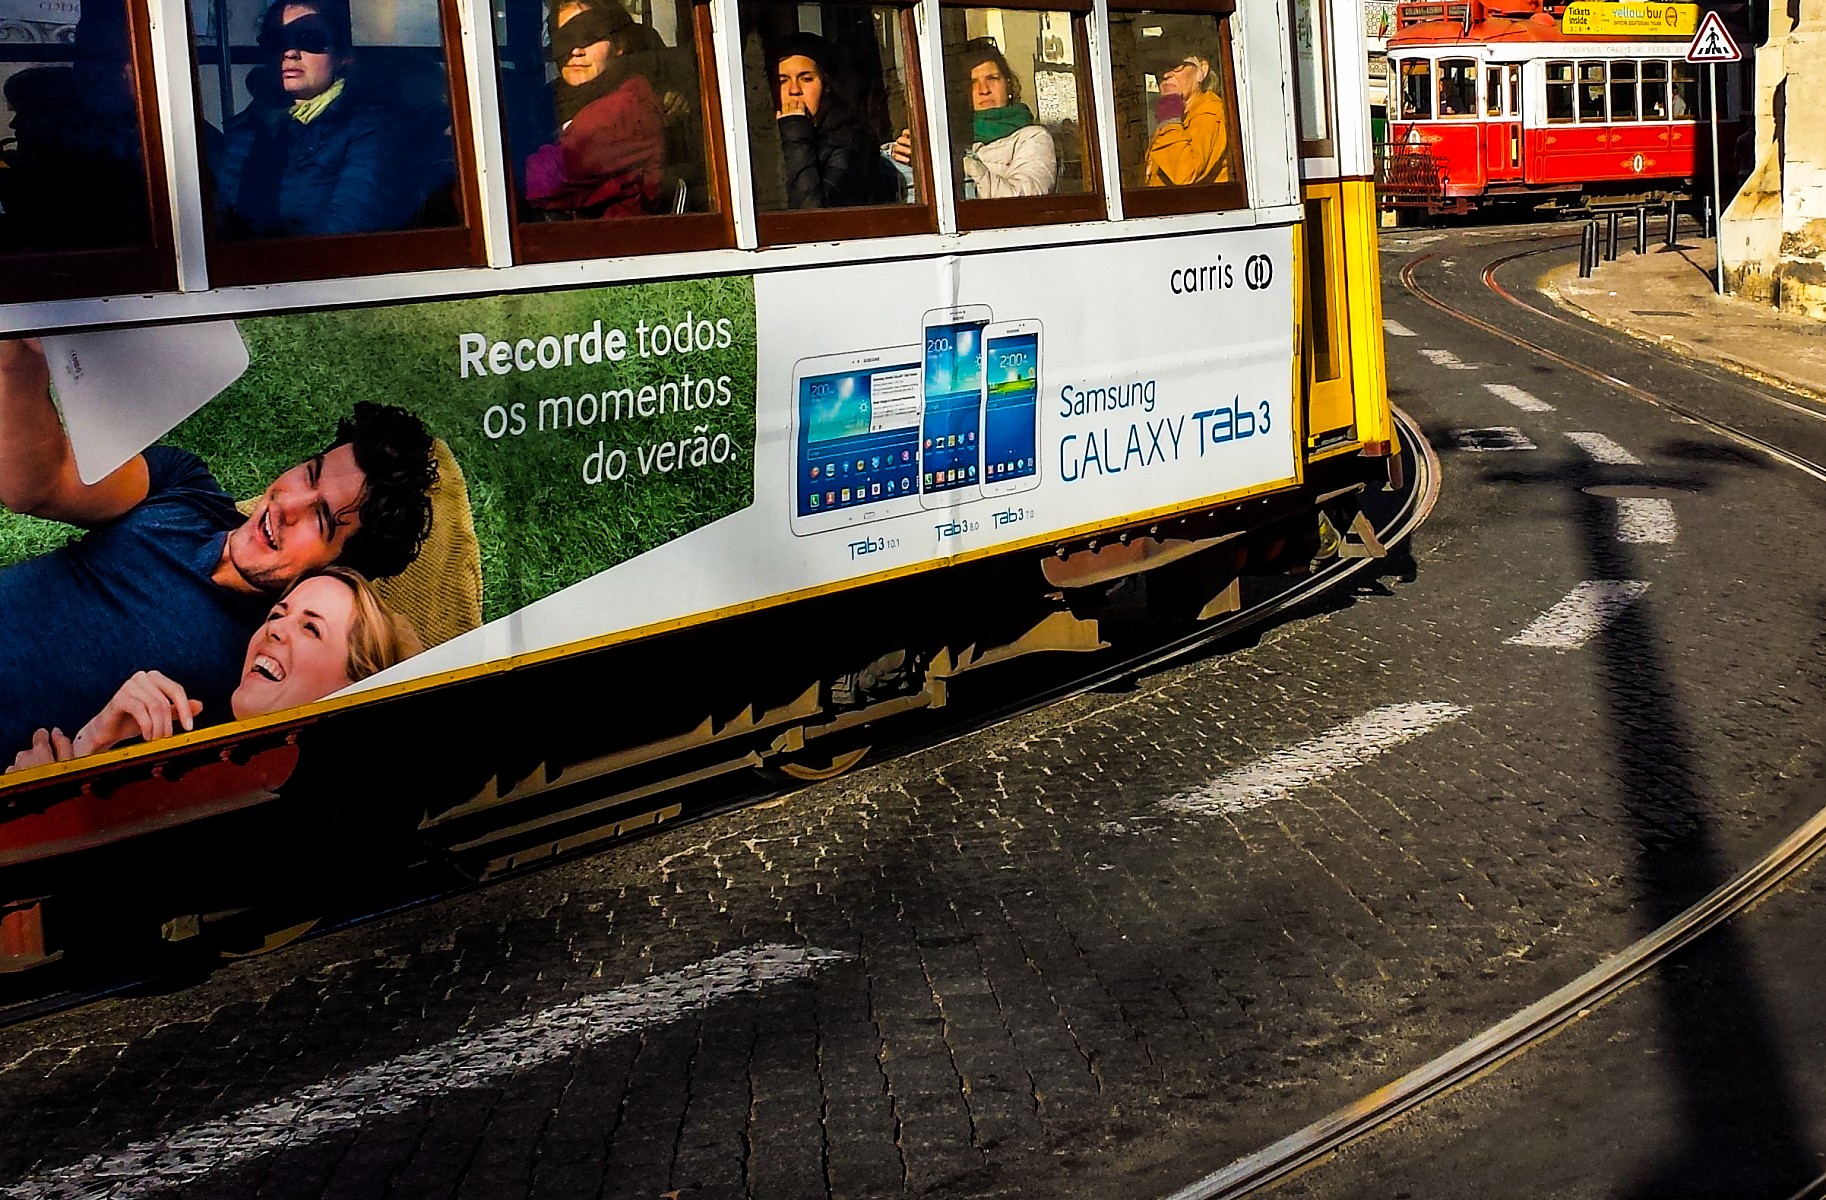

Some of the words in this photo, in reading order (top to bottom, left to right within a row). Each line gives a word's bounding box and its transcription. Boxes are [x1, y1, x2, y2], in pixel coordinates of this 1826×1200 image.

[1569, 7, 1591, 16] Tickets
[1170, 254, 1233, 295] carris
[459, 319, 627, 379] Recorde
[635, 311, 732, 359] todos
[483, 402, 526, 440] os
[538, 373, 732, 432] momentos
[1060, 380, 1156, 418] Samsung
[583, 440, 627, 486] do
[637, 424, 737, 477] verão.
[1059, 414, 1185, 483] GALAXY
